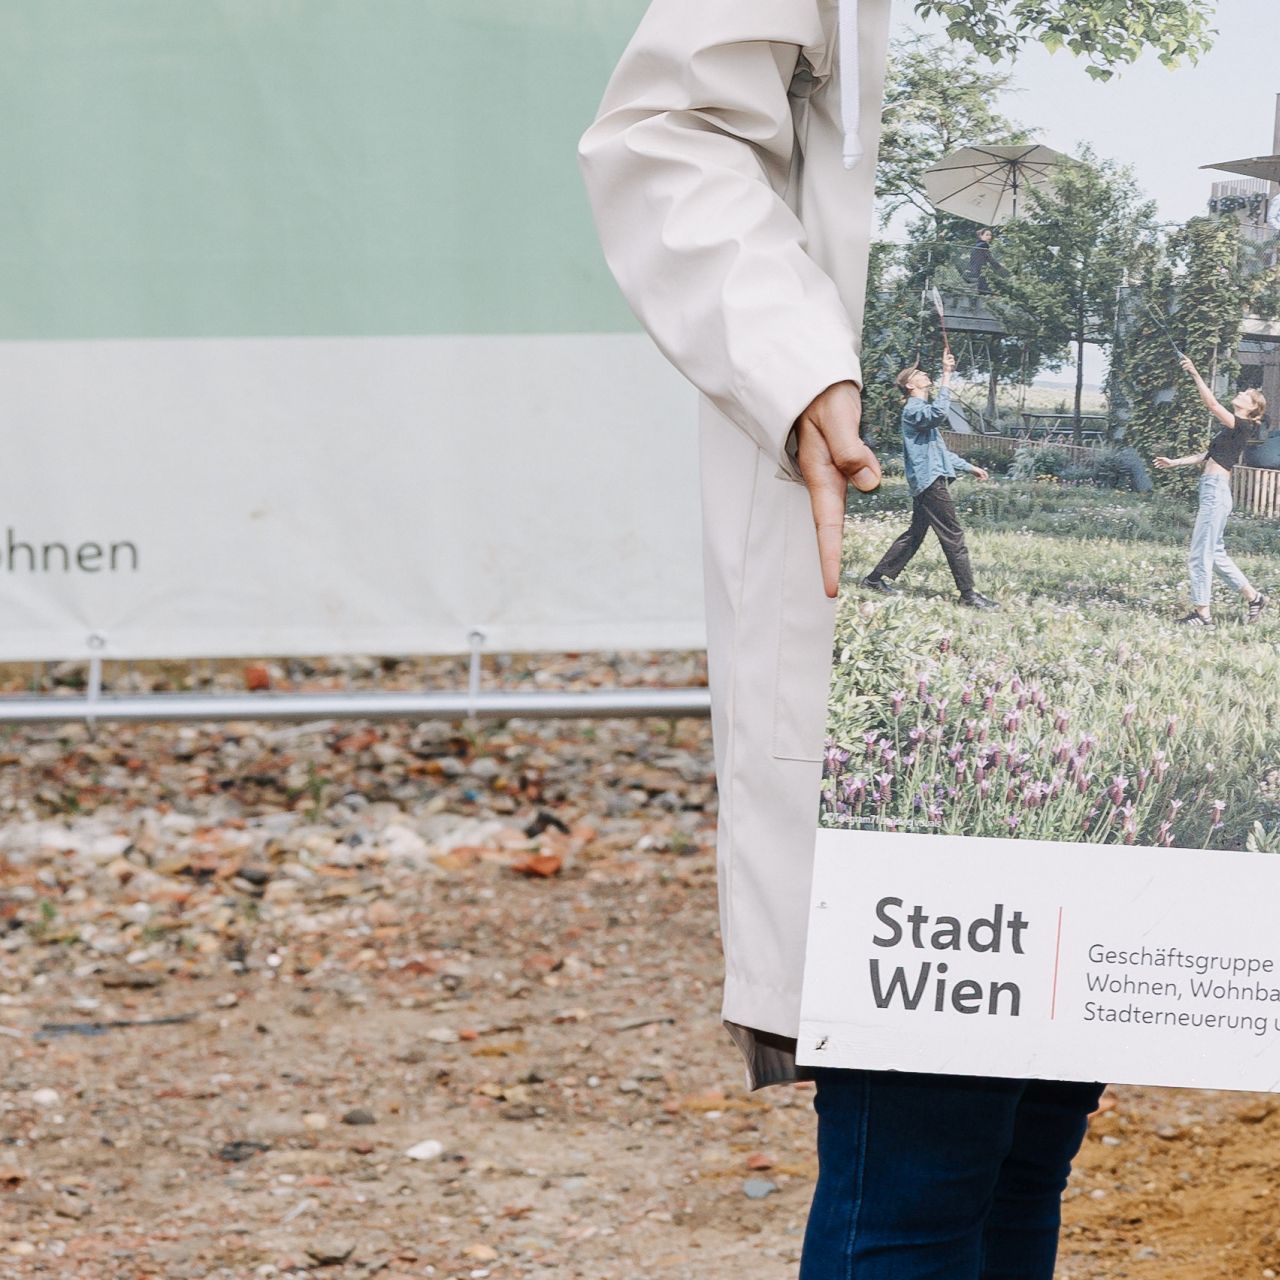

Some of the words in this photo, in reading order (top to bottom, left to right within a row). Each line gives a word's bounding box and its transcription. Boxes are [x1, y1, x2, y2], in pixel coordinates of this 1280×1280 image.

[0, 526, 139, 572] hnen
[873, 896, 1029, 955] Stadt
[1088, 944, 1274, 977] Geschäftsgruppe
[869, 959, 1021, 1017] Wien
[1086, 973, 1183, 1001] Wohnen,
[1084, 1002, 1268, 1036] Stadterneuerung
